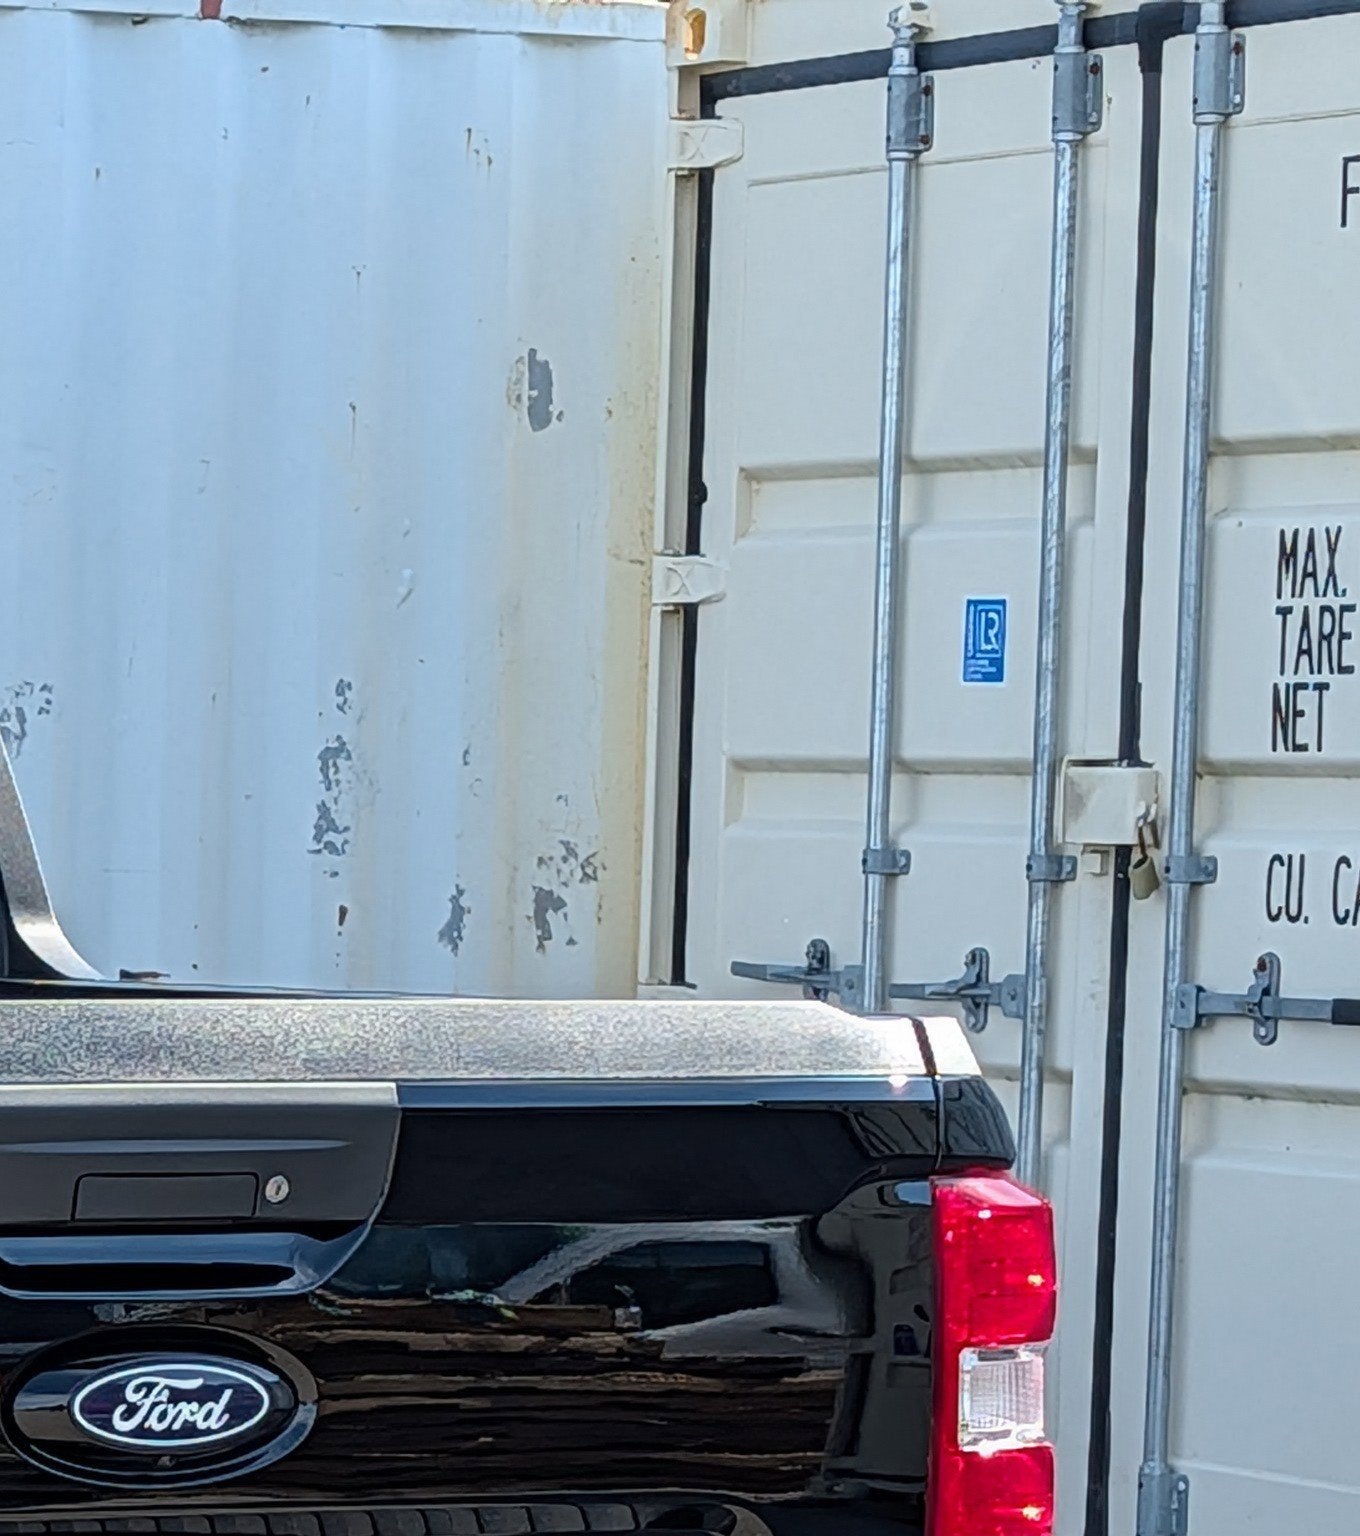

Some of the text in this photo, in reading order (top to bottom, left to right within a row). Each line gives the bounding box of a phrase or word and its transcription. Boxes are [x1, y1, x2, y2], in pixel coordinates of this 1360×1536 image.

[1276, 525, 1347, 599] MAX.
[1275, 603, 1357, 676] TARE
[1271, 682, 1330, 752] NET
[1265, 853, 1309, 924] CU.
[111, 1375, 234, 1432] Ford
